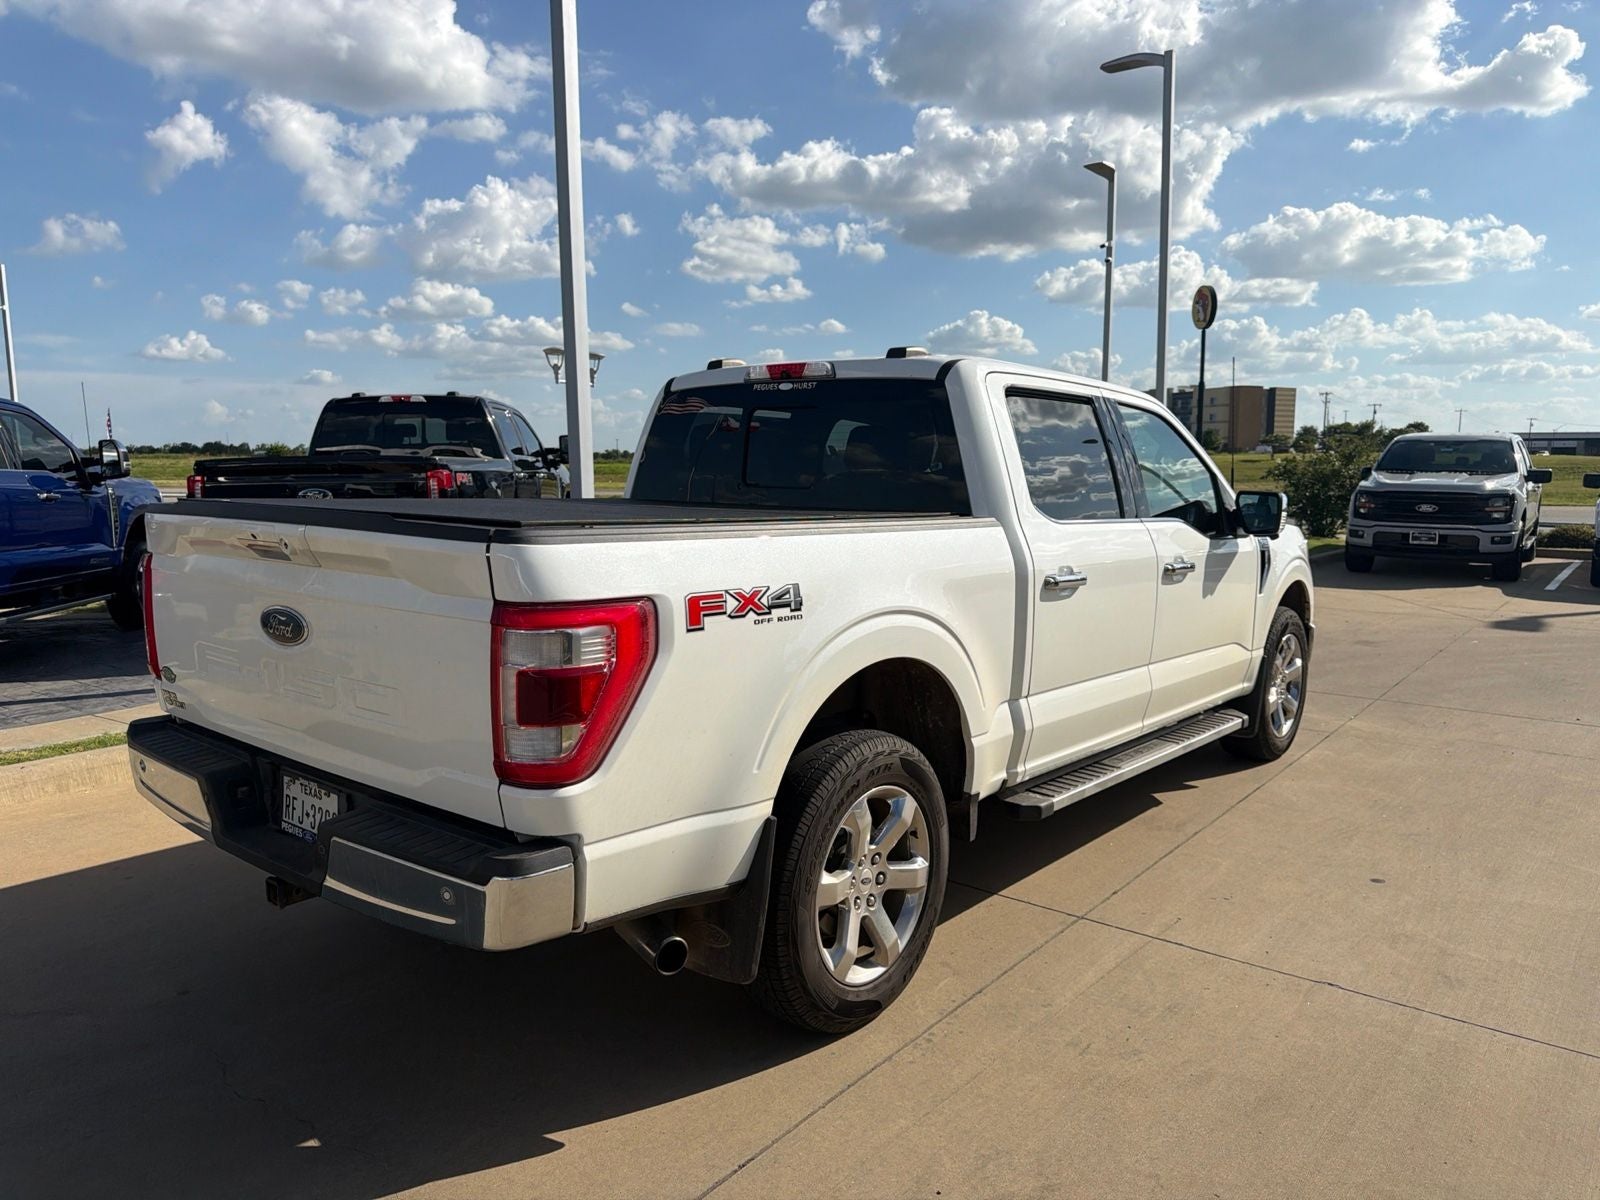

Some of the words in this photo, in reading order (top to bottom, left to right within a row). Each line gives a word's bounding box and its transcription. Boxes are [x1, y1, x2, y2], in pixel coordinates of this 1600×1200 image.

[753, 383, 779, 391] PEGUES
[793, 382, 818, 390] HURST
[684, 583, 803, 633] FX4
[267, 613, 294, 638] Ford
[754, 618, 774, 626] OFF
[777, 613, 803, 623] ROAD
[300, 782, 323, 800] TEXAS
